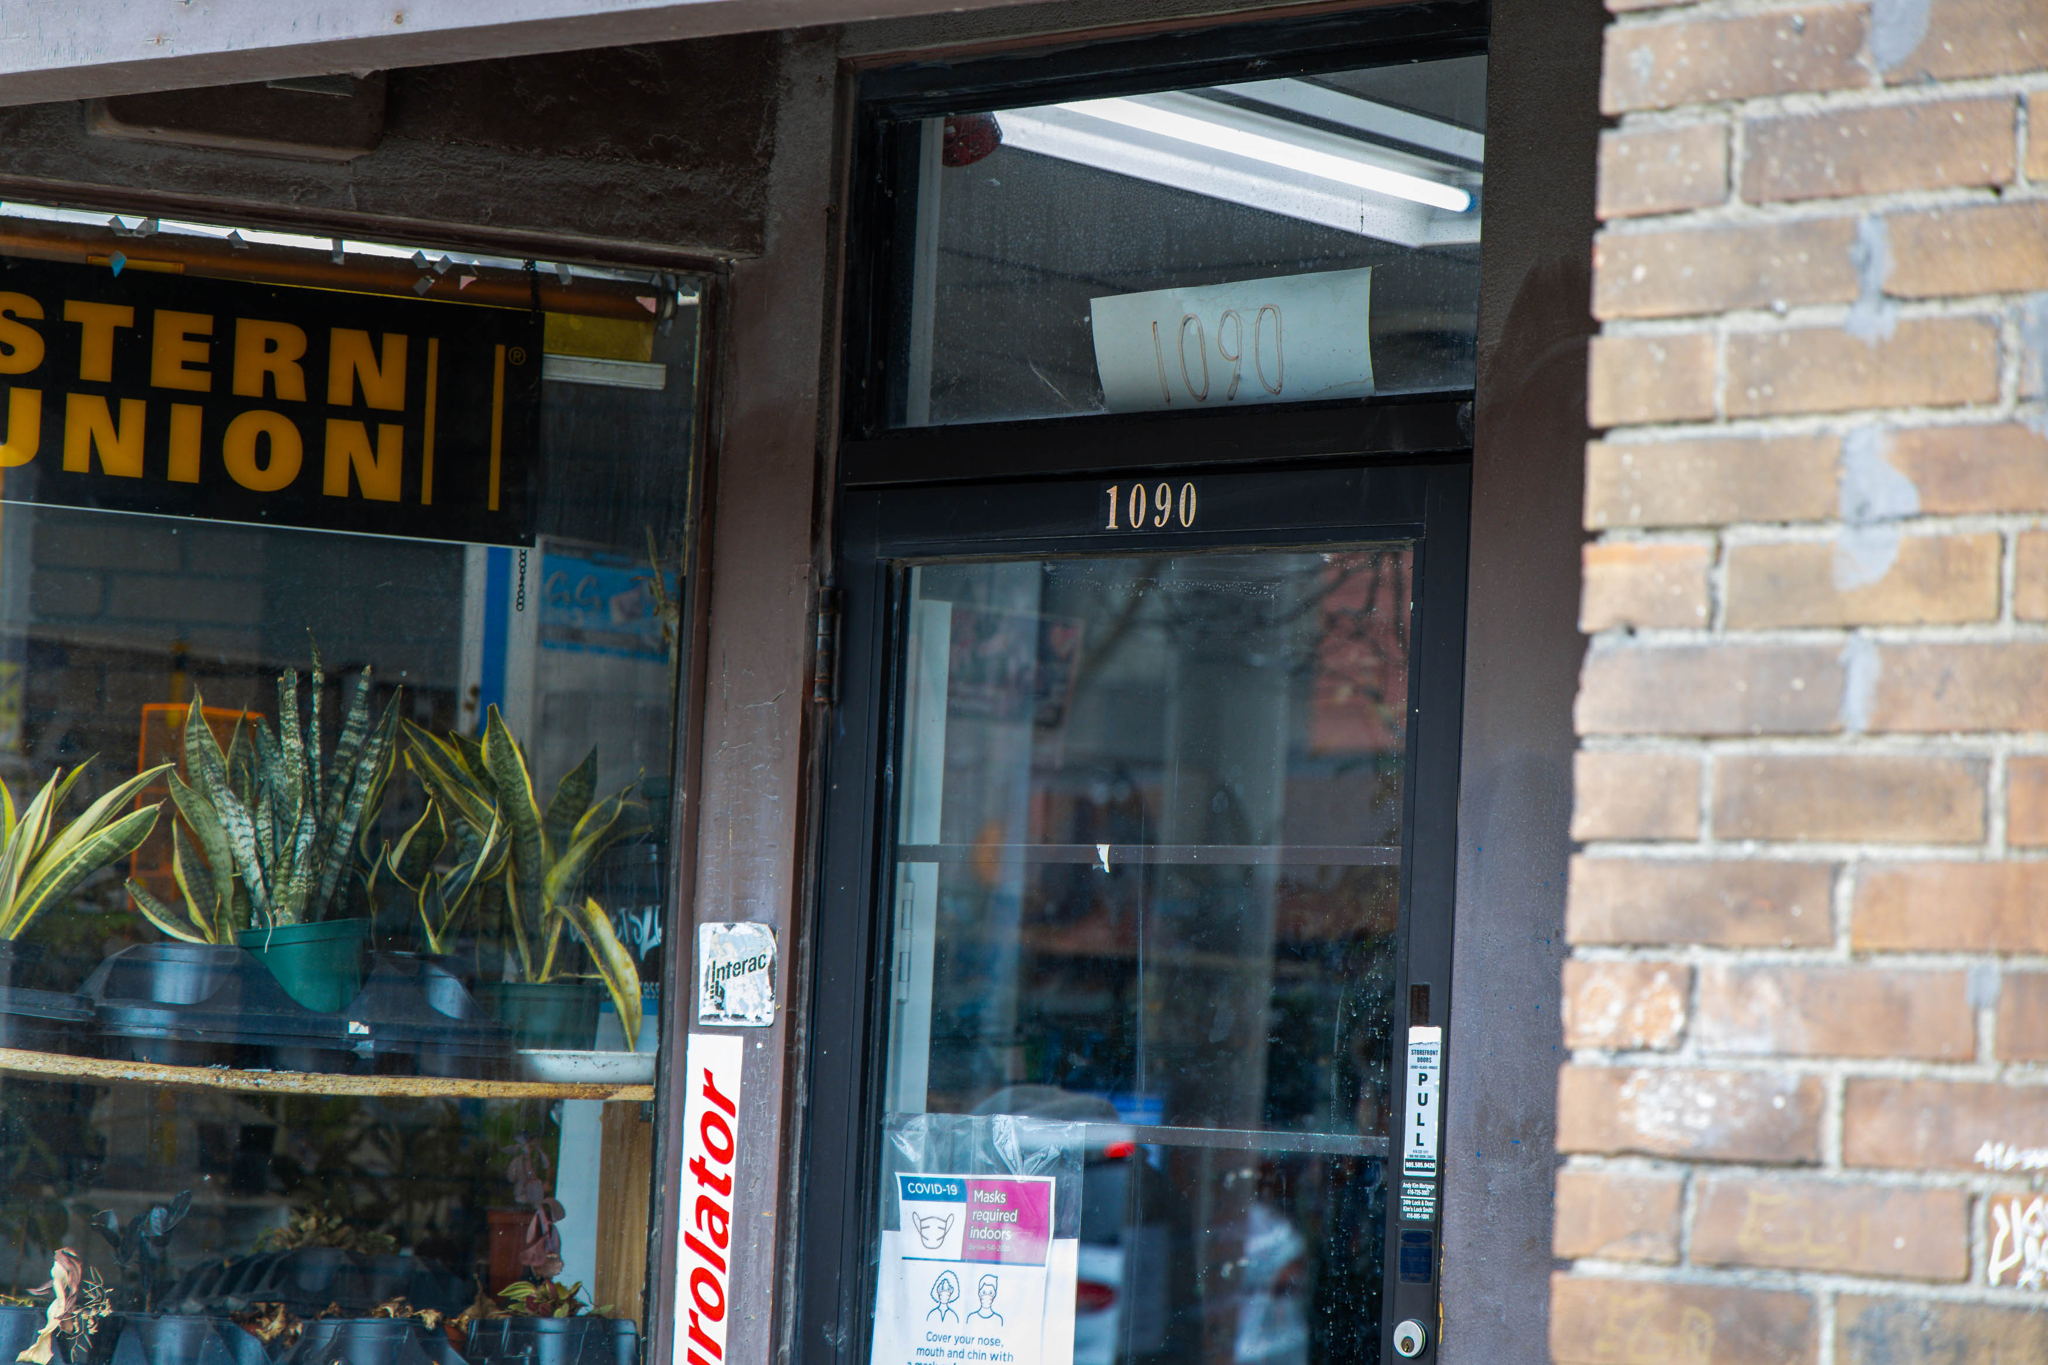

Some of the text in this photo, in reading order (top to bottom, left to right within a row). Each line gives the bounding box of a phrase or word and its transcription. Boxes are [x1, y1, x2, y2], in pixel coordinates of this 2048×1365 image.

[0, 291, 408, 412] STERN
[1152, 303, 1284, 406] 1090
[1105, 482, 1198, 530] 1090
[711, 953, 767, 983] Interac
[1417, 1073, 1428, 1146] PULL
[907, 1182, 958, 1196] COVID-19
[973, 1189, 1007, 1204] Masks
[972, 1208, 1018, 1223] required
[969, 1225, 1012, 1240] indoors
[926, 1331, 1004, 1348] Cover your nose,
[916, 1346, 1014, 1362] mouth and chin with
